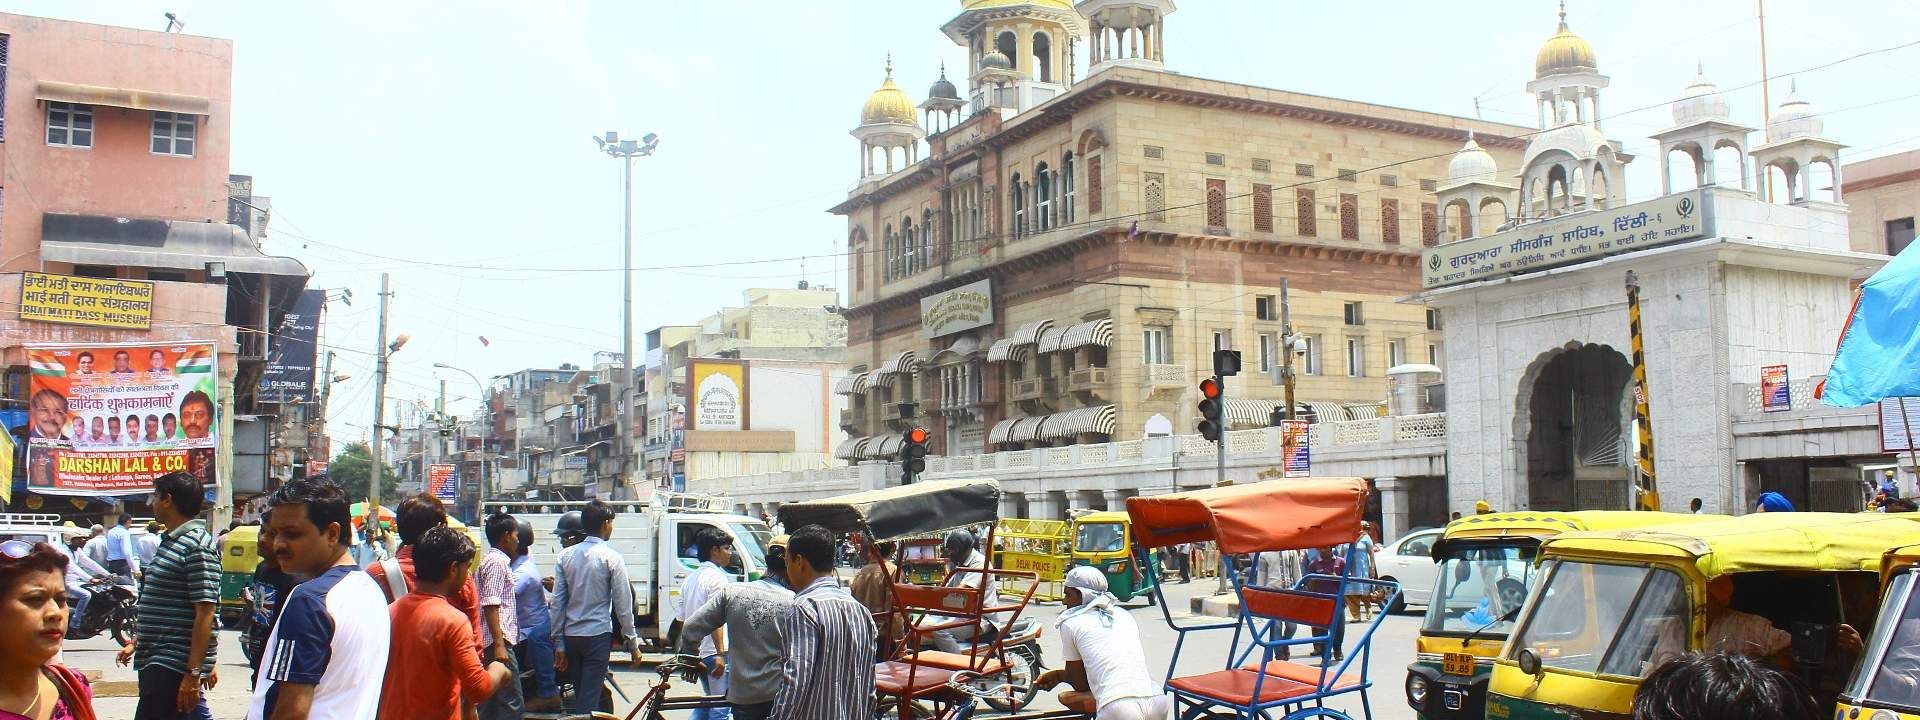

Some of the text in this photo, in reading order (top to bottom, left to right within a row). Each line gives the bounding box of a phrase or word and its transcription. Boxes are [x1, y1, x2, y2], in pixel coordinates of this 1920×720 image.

[1450, 246, 1502, 268] ਗੁਰਦੁਆਰਾ
[1510, 234, 1555, 253] ਸੀਸਗੰਜ
[49, 278, 69, 290] ਮਤੀ
[71, 281, 92, 292] ਦਾਸ
[25, 290, 151, 312] भाई मती दास संग्रहालय
[24, 305, 148, 325] BHAI MATI DASS MUSEUM
[68, 394, 104, 410] हार्दिक
[1635, 386, 1644, 402] STOP
[59, 456, 120, 474] DARSHAN
[124, 457, 149, 473] LAL
[152, 456, 162, 471] &
[166, 455, 187, 471] CO.
[1016, 559, 1050, 571] DELHI POLICE
